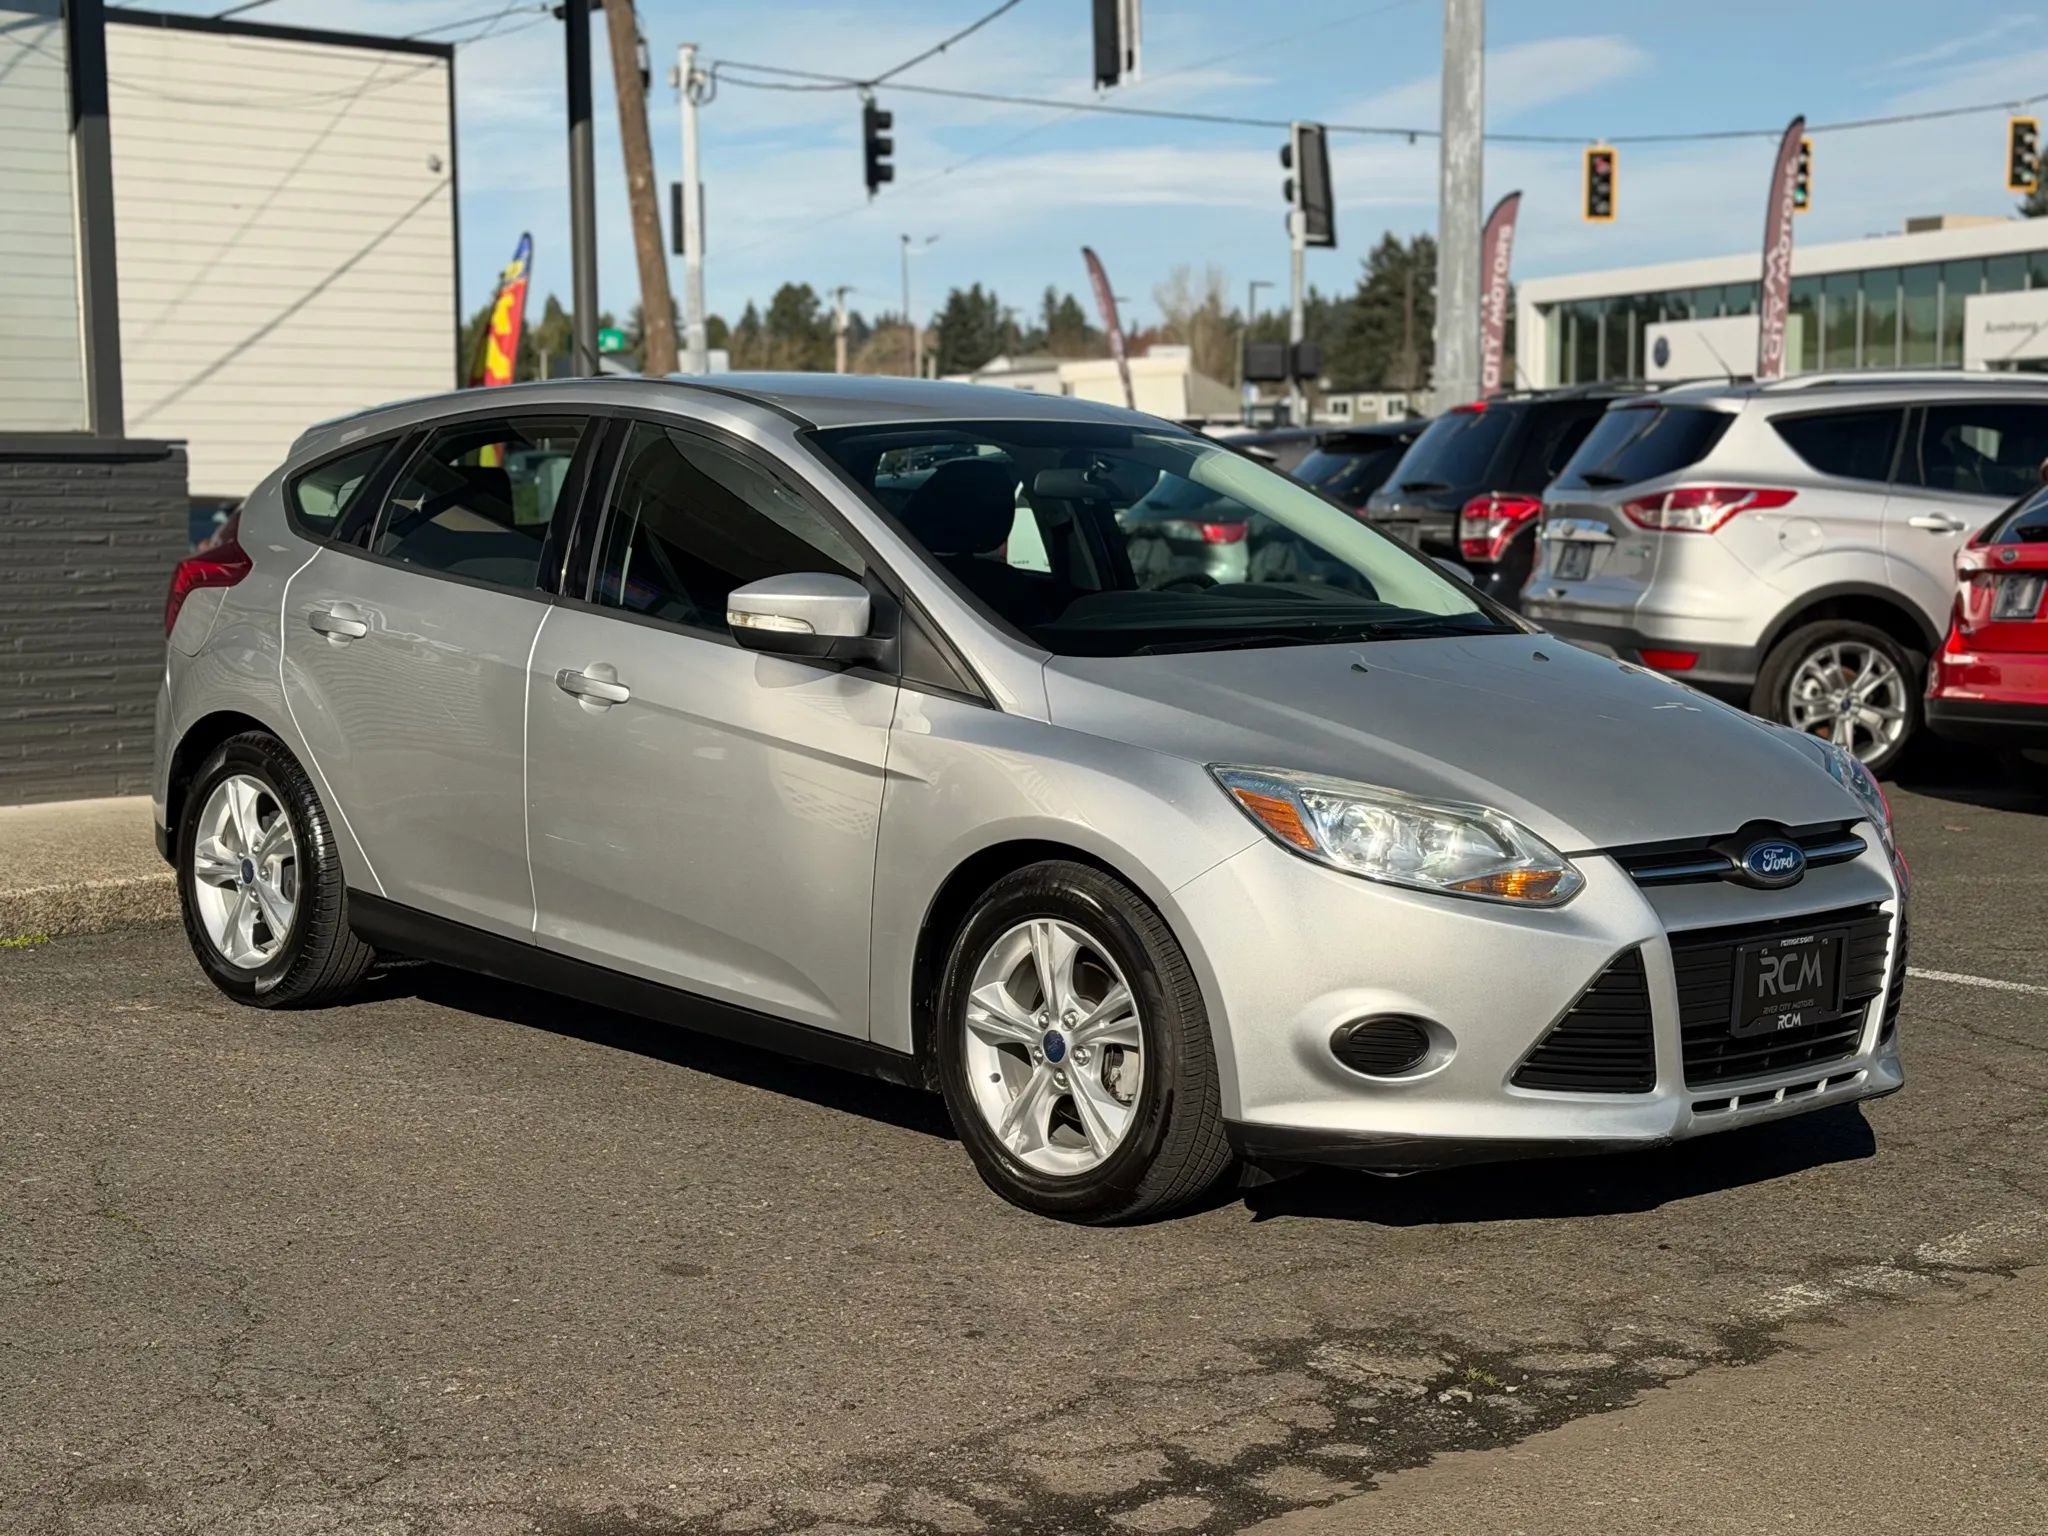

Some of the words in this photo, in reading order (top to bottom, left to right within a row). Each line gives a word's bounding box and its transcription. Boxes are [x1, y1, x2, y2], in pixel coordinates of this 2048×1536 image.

[1778, 156, 1799, 283] MOTORS
[1490, 224, 1513, 326] MOTORS
[1483, 334, 1501, 388] CITY
[1762, 847, 1796, 872] Ford
[1758, 948, 1823, 998] RCM
[1777, 1012, 1802, 1030] RCM
